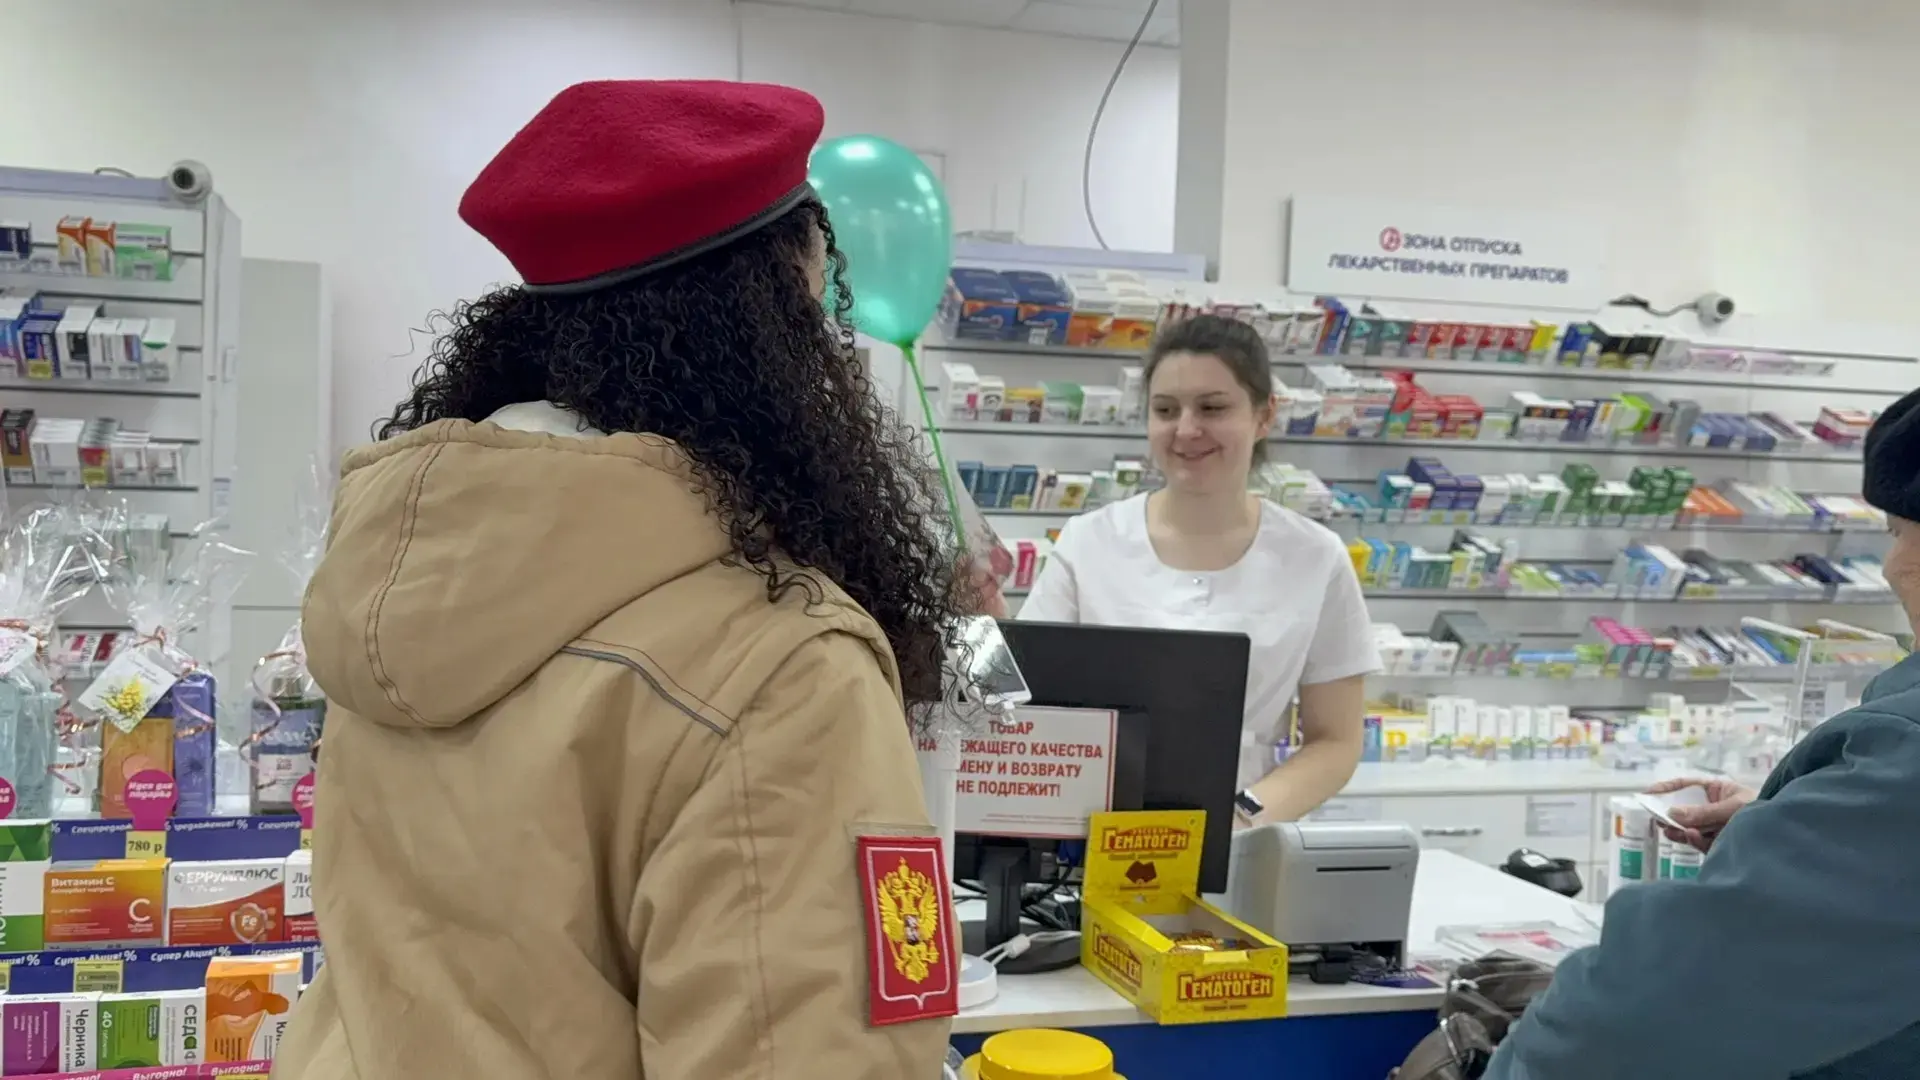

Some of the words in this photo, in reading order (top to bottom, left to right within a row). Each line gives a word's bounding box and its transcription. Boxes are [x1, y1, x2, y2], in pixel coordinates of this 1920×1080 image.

[1402, 233, 1446, 250] ЗОНА
[1450, 236, 1522, 255] ОТПУСКА
[1327, 253, 1466, 277] ЛЕКАРСТВЕННЫХ
[1469, 262, 1568, 284] ПРЕПАРАТОВ
[1031, 742, 1103, 758] КАЧЕСТВА
[957, 759, 994, 774] МЕНУ
[997, 763, 1007, 775] И
[1011, 762, 1082, 778] ВОЗВРАТУ
[956, 780, 975, 793] НЕ
[978, 781, 1061, 797] ПОДЛЕЖИТ!
[128, 840, 151, 852] 780
[1103, 829, 1188, 850] ГЕМАТОГЕН
[51, 878, 104, 888] Витамин
[241, 914, 258, 927] Fe
[150, 951, 182, 963] Супер
[1179, 975, 1273, 1001] ГЕМАТОГЕН
[72, 1009, 89, 1068] Черника
[132, 1067, 188, 1080] Выгодно!
[211, 1062, 265, 1077] Выгодно!
